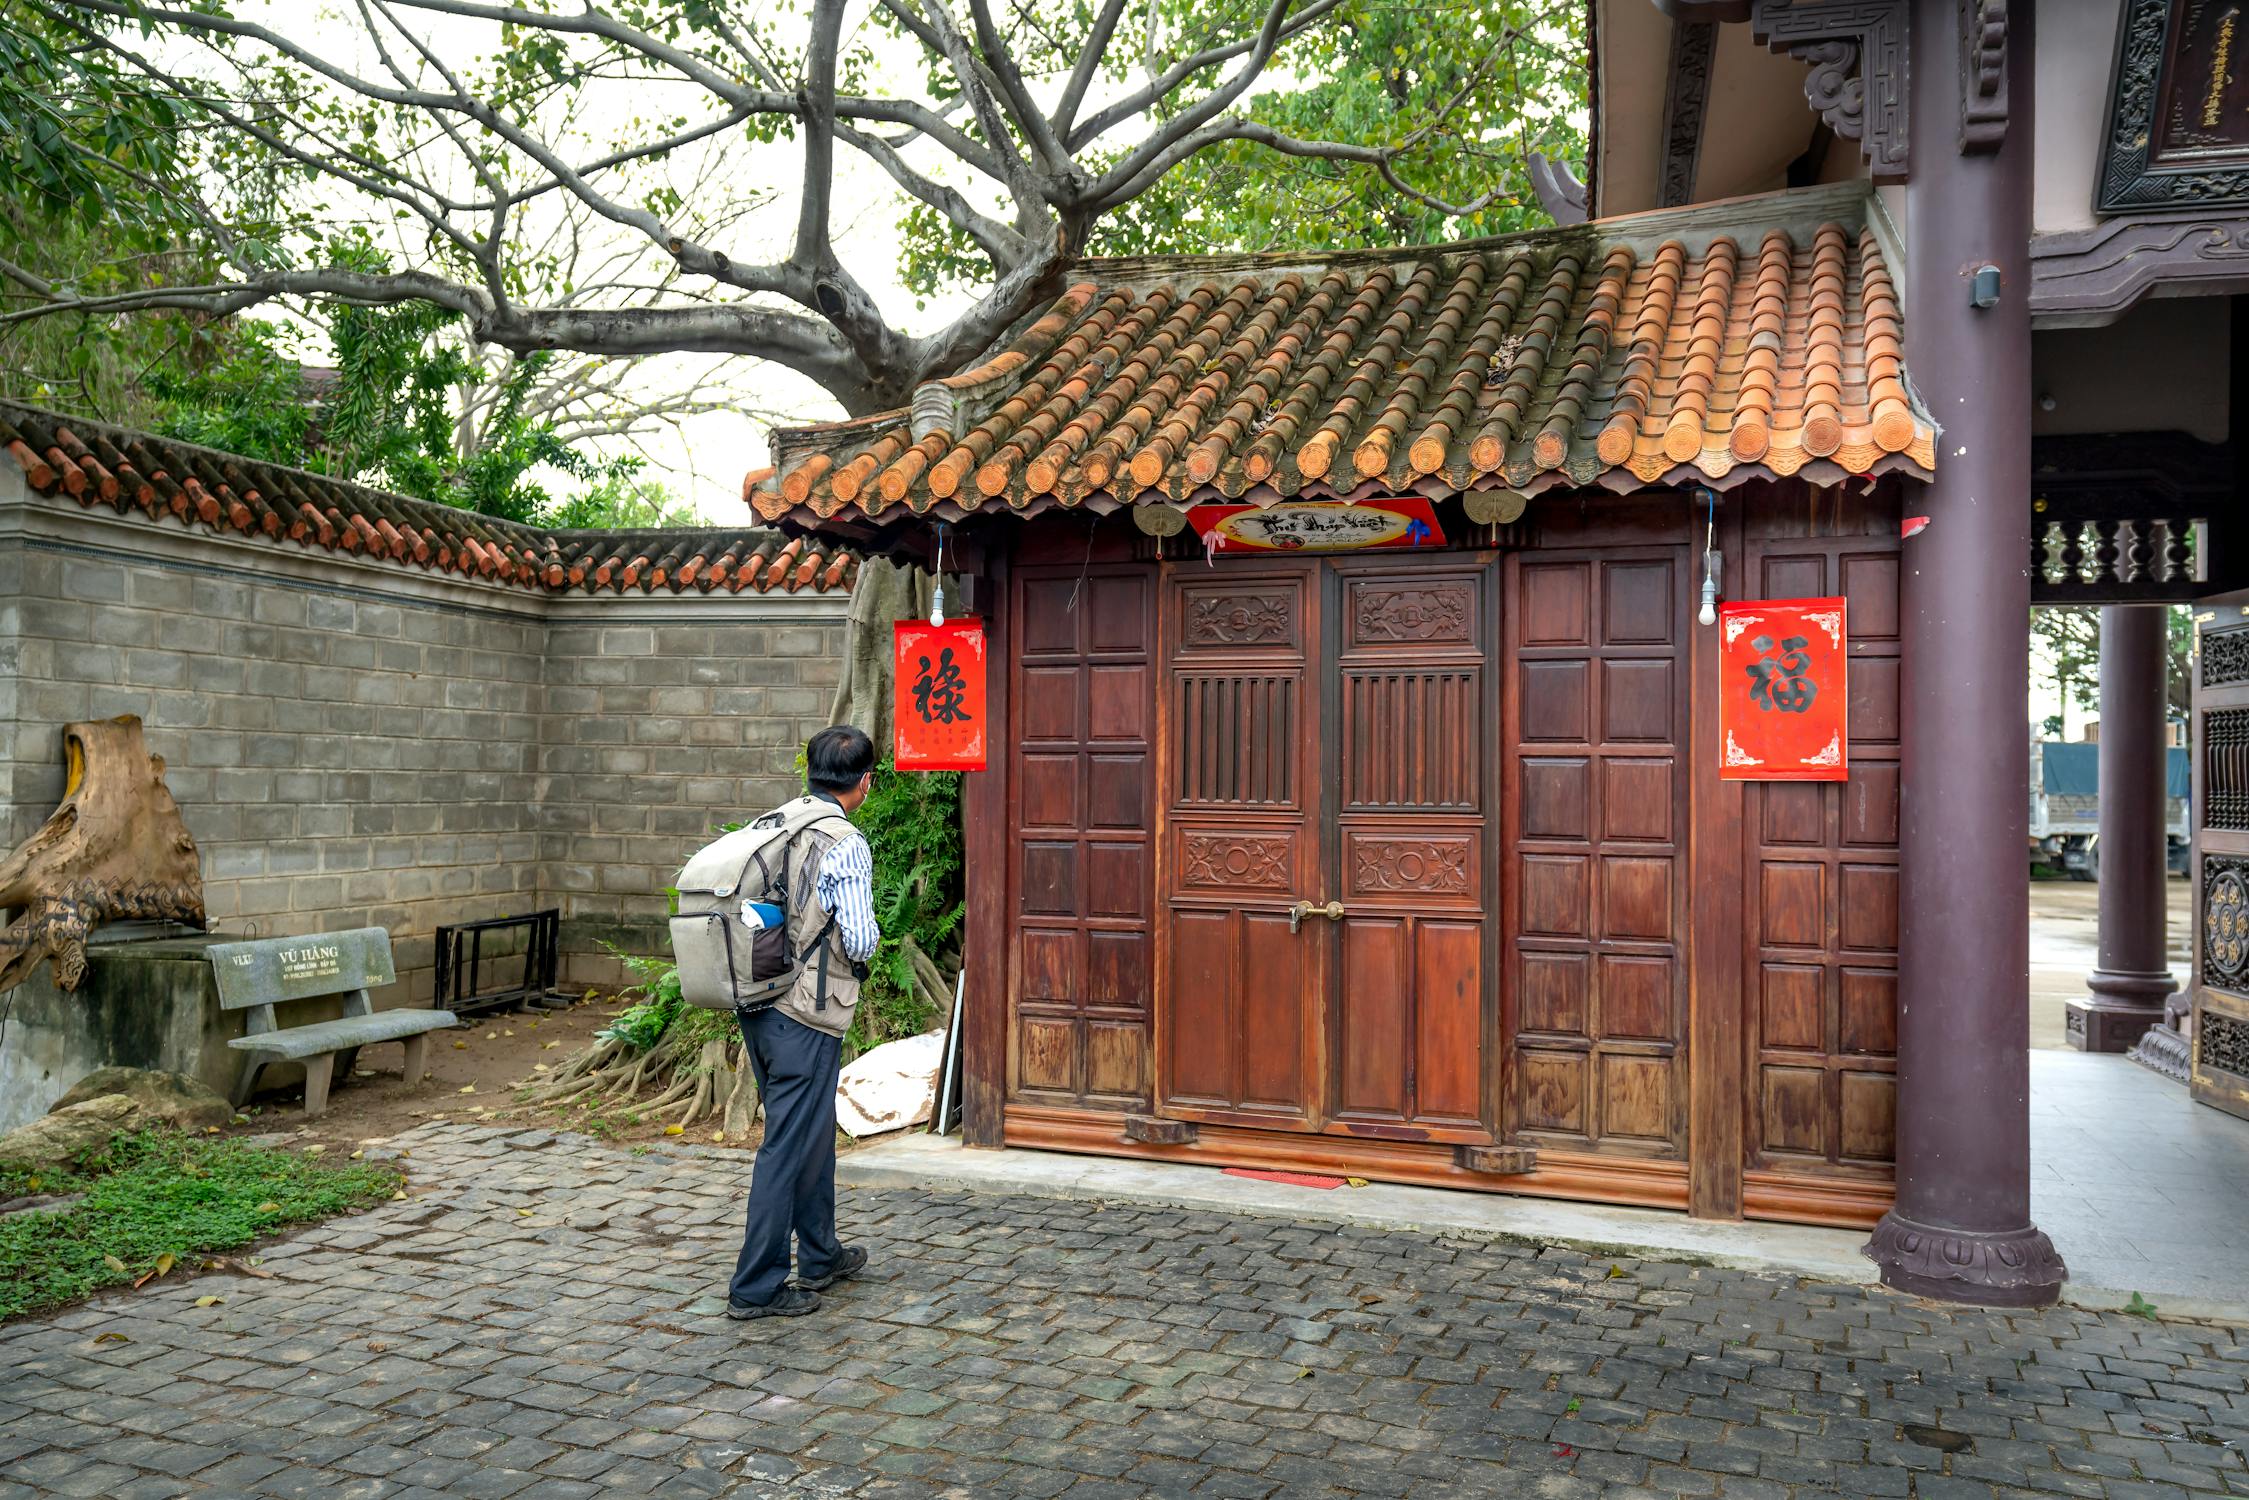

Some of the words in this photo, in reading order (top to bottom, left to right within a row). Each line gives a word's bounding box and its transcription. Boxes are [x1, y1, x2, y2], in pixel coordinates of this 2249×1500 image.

[1745, 635, 1819, 713] 福
[279, 947, 298, 964] VŨ
[301, 943, 338, 961] HẰNG
